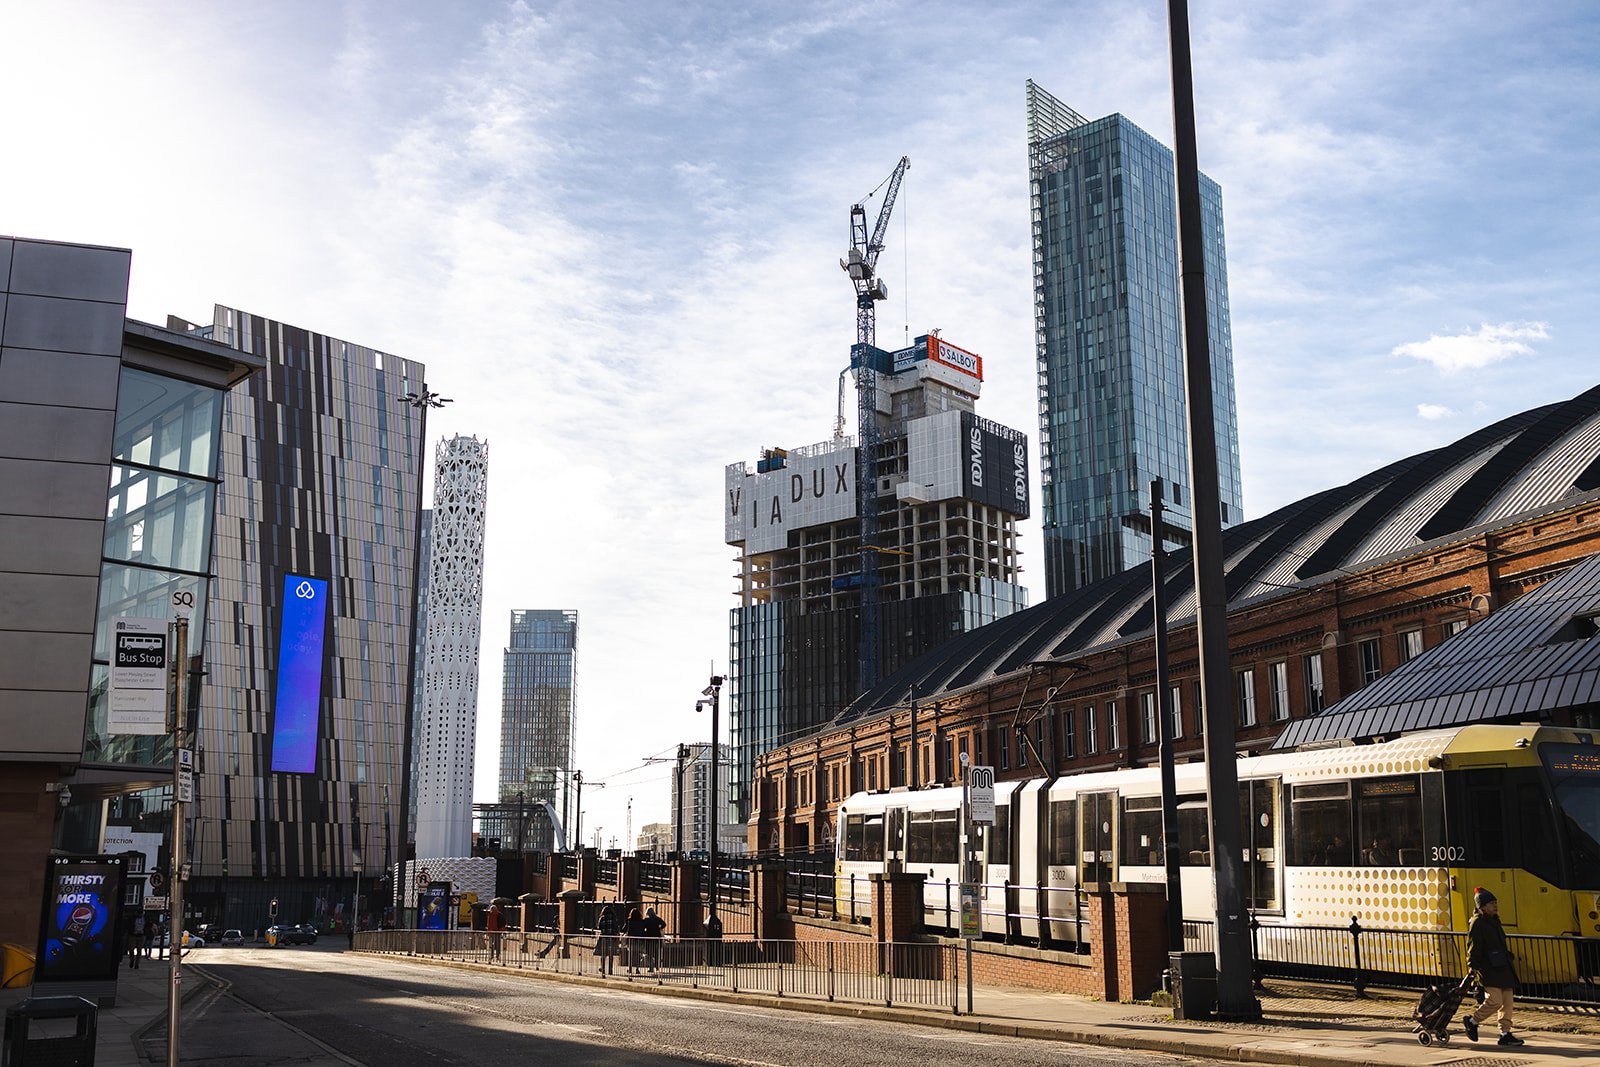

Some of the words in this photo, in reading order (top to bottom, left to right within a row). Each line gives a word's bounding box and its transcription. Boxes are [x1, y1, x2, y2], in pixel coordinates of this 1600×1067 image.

[946, 347, 976, 370] SALBOY
[970, 427, 983, 487] DOMIS
[1013, 443, 1026, 501] DOMIS
[729, 463, 848, 529] VIADUX
[173, 591, 193, 608] SQ
[119, 652, 138, 662] Bus
[140, 653, 162, 666] Stop
[1431, 846, 1466, 862] 3002
[58, 875, 107, 885] THIRSTY
[1051, 870, 1066, 881] 3002
[56, 894, 91, 904] MORE
